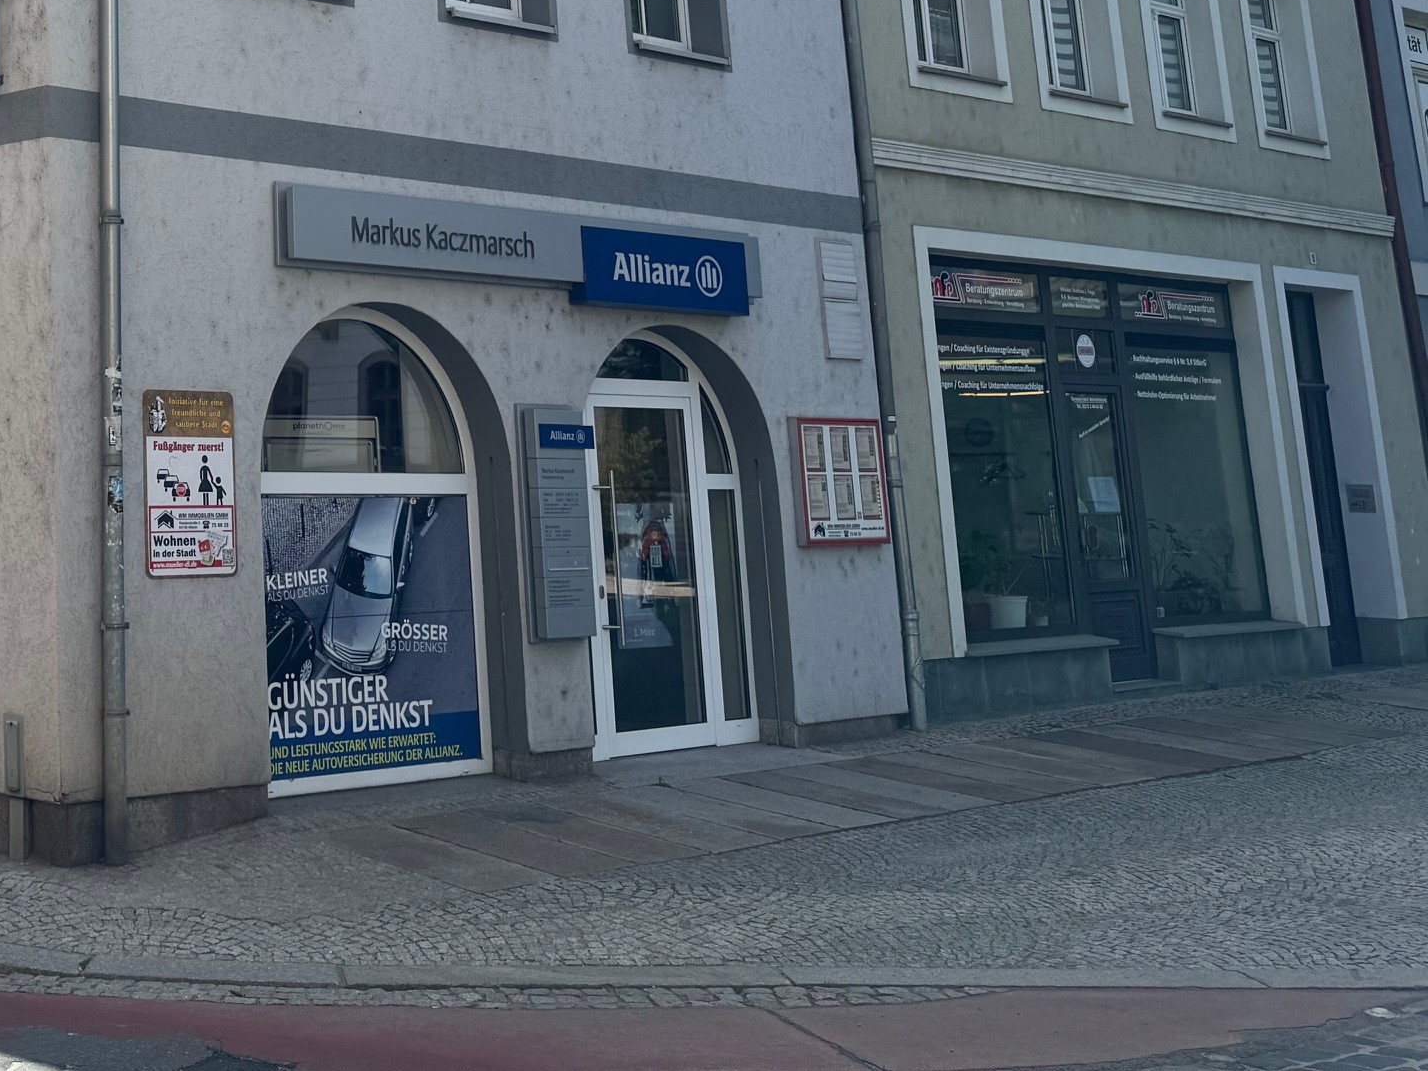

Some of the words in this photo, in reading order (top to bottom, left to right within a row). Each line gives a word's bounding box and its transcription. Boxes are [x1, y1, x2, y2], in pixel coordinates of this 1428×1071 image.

[351, 216, 421, 248] Markus
[426, 223, 535, 259] Kaczmarsch
[613, 252, 691, 288] Allianz
[965, 283, 1024, 297] Beratungszentrum
[1167, 300, 1215, 313] Beratungszentrum
[954, 344, 976, 354] Coaching
[958, 380, 980, 390] Coaching
[168, 397, 197, 406] Initiative
[199, 397, 208, 406] für
[210, 398, 224, 407] eine
[172, 409, 207, 417] freundliche
[201, 420, 218, 429] Stadt
[550, 430, 575, 441] Allianz
[153, 440, 196, 453] Fußgänger
[197, 442, 224, 452] zuerst!
[153, 535, 196, 547] Wohnen
[153, 549, 160, 558] in
[162, 549, 174, 558] der
[176, 548, 197, 557] Stadt
[266, 568, 328, 590] KLEINER
[267, 592, 282, 603] ALS
[283, 589, 296, 601] DU
[297, 585, 329, 599] DENKST
[381, 619, 448, 641] GRÖSSER
[382, 639, 397, 651] LS
[398, 640, 411, 651] DU
[413, 640, 448, 653] DENKST
[268, 673, 389, 710] GÜNSTIGER
[269, 709, 307, 740] ALS
[313, 706, 345, 736] DU
[352, 699, 433, 733] DENKST
[291, 739, 367, 757] LEISTUNGSSTARK
[369, 737, 386, 750] WIE
[388, 732, 436, 748] ERWARTET:
[270, 762, 283, 775] DIE
[285, 760, 310, 774] NEUE
[311, 751, 403, 771] AUTOVERSICHERUNG
[406, 748, 423, 761] DER
[424, 745, 463, 759] ALLIANZ.
